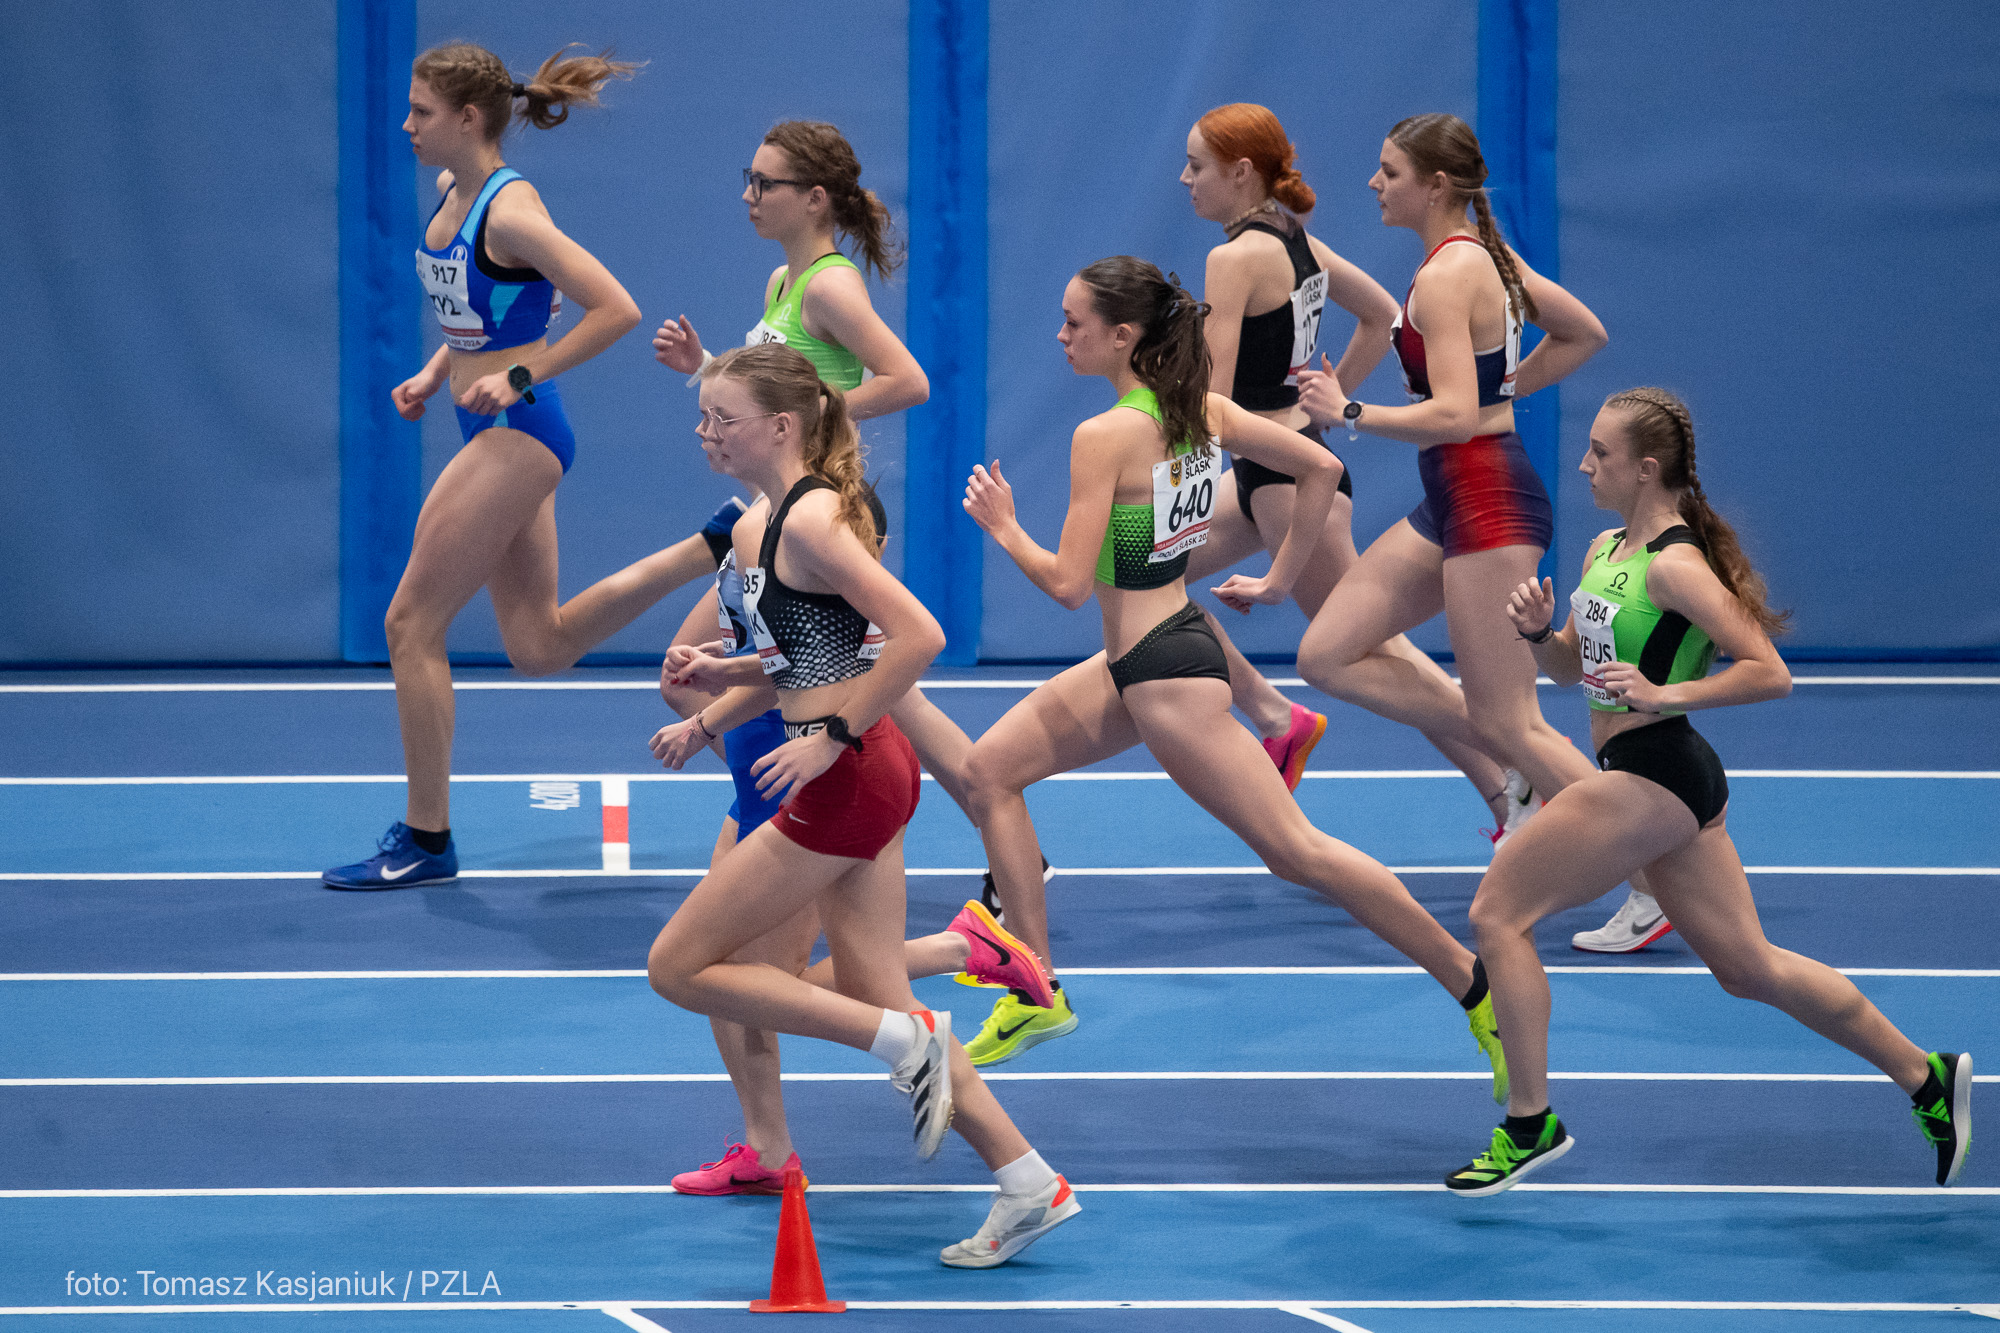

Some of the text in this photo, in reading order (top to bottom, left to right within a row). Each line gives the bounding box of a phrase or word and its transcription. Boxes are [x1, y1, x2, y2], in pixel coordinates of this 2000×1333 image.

[431, 263, 457, 285] 917
[1169, 478, 1212, 533] 640
[1585, 599, 1609, 625] 284
[784, 722, 825, 740] NIKE
